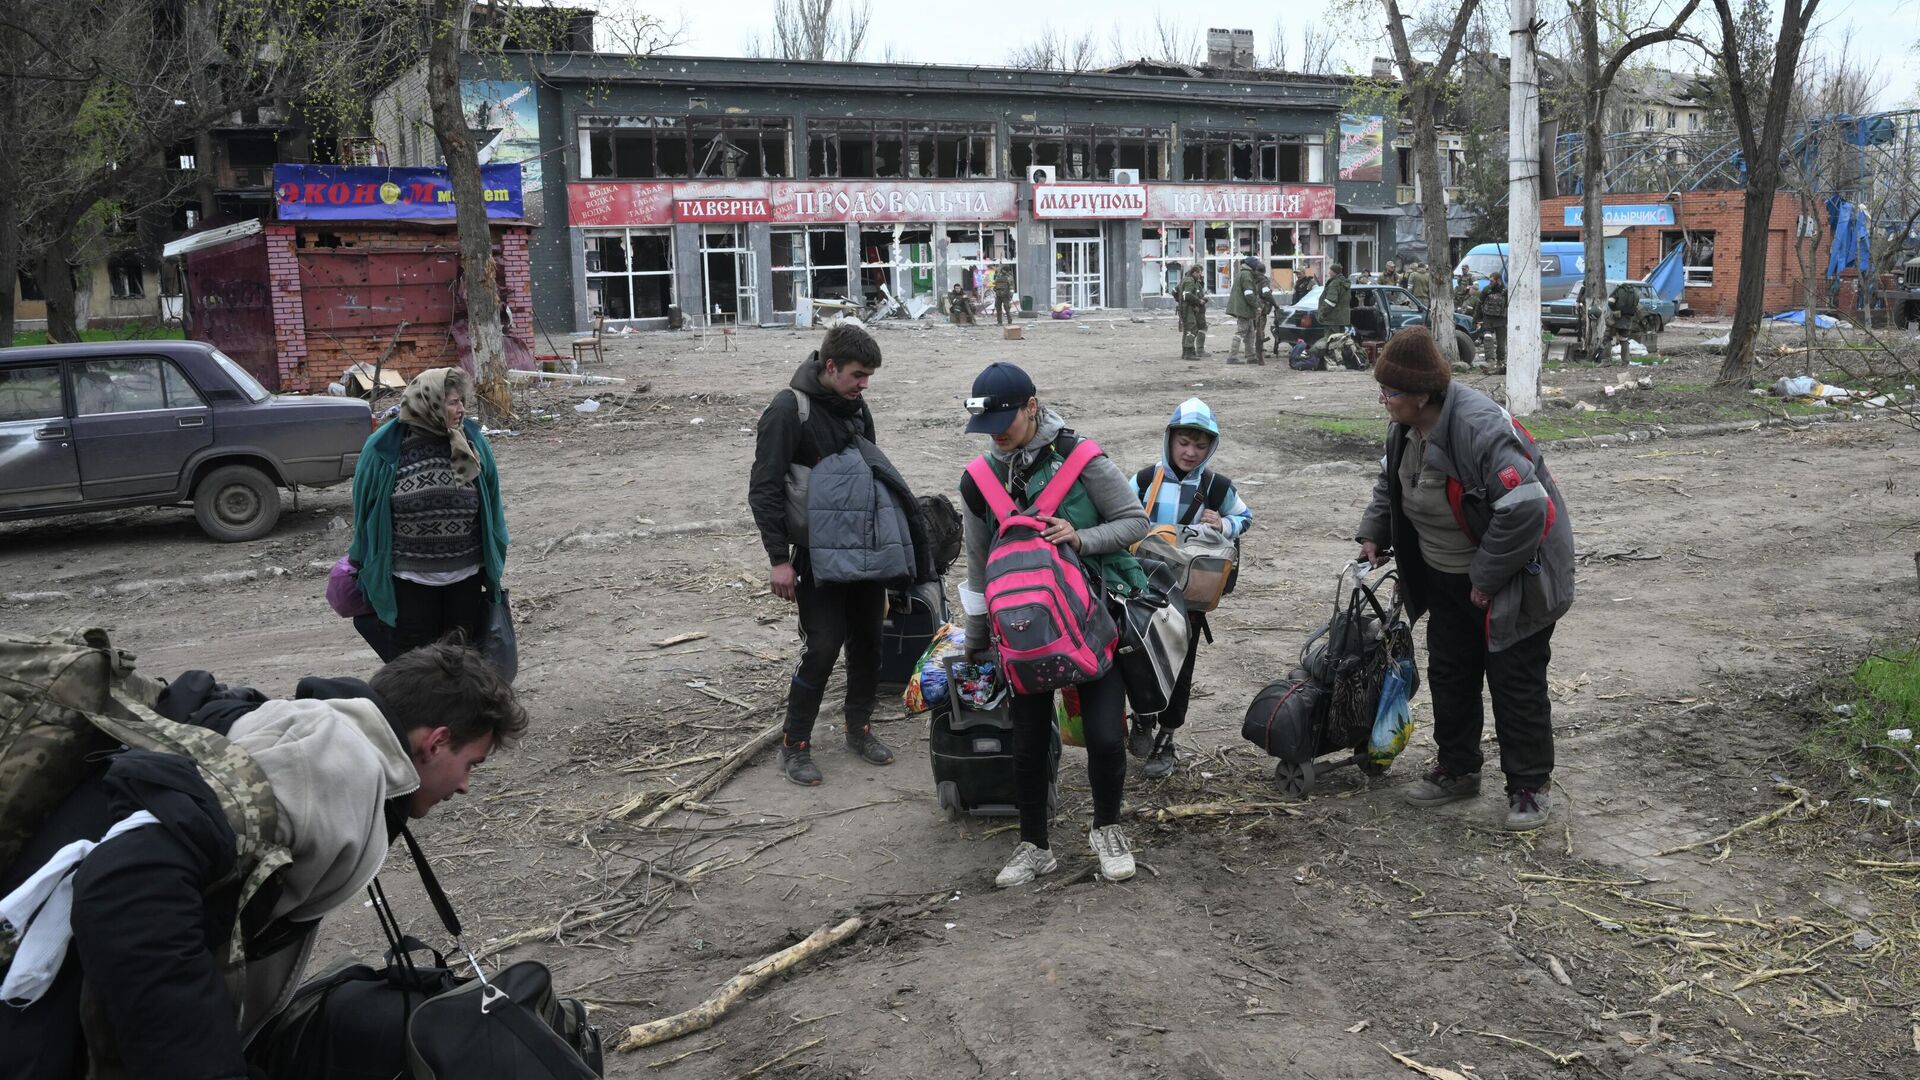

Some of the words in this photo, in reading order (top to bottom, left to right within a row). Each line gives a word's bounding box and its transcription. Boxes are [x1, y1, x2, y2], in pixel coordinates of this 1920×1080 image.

[588, 184, 619, 199] ВОДКА
[636, 184, 664, 198] ТАБАК
[585, 194, 615, 209] ВОДКА
[632, 194, 660, 208] ТАБАК
[679, 201, 766, 216] ТАВЕРНА
[795, 191, 992, 217] ПРОДОВОЛЬЧА
[1040, 193, 1143, 214] МАРІУПОЛЬ
[1172, 192, 1301, 218] КРАМНИЦЯ
[581, 205, 612, 219] ВОДКА
[628, 204, 656, 218] ТАБАК
